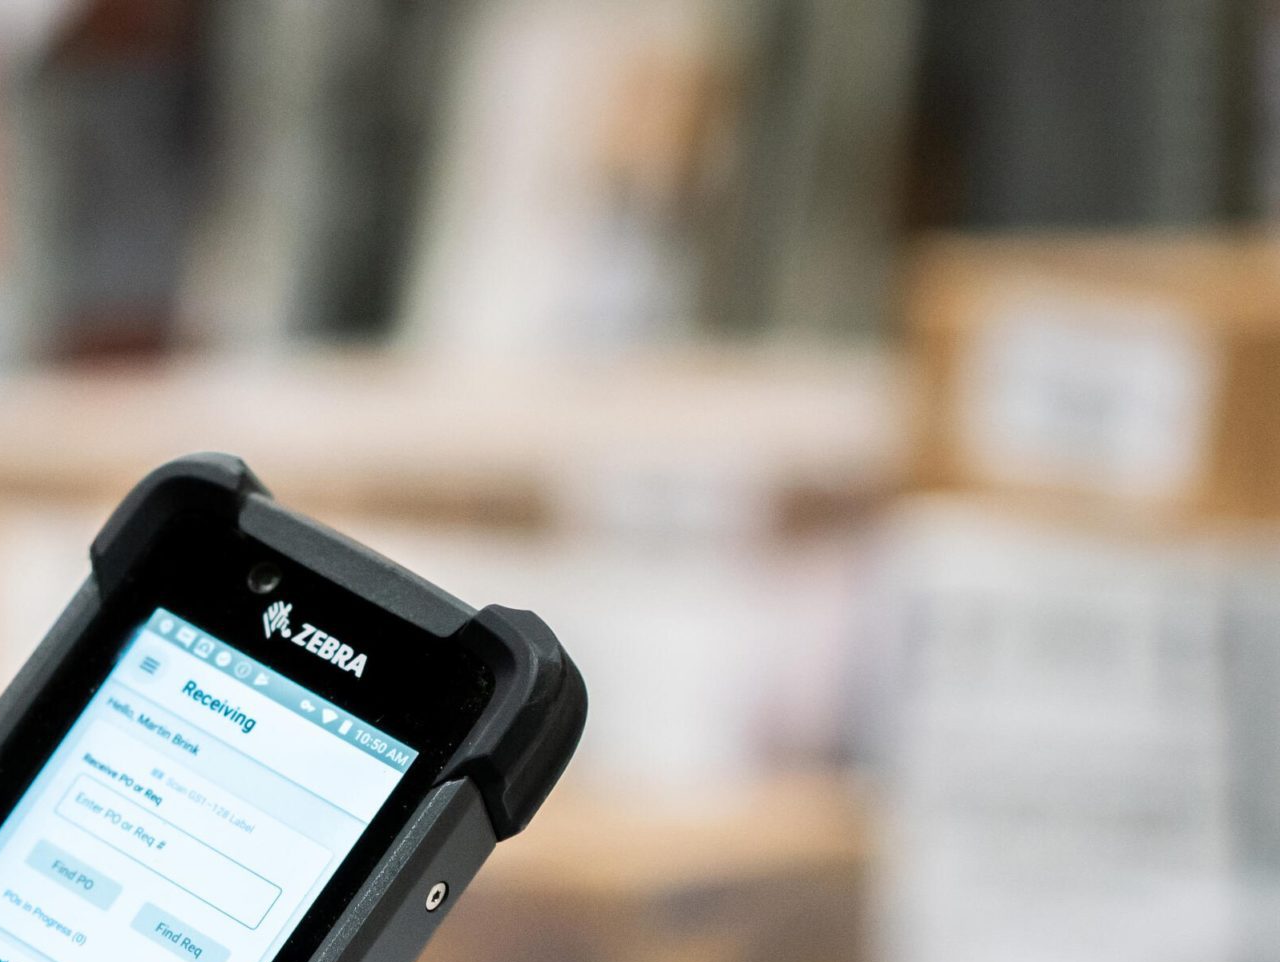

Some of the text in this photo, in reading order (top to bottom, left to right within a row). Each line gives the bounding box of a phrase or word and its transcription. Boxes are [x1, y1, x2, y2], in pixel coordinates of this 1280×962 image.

[290, 622, 368, 678] ZEBRA
[107, 697, 199, 756] Hello, Martin Brink
[182, 680, 257, 734] Receiving
[354, 729, 410, 767] 10:50 AM
[83, 752, 163, 807] Receive PO or Req
[74, 791, 166, 850] Enter PO or Req #
[228, 814, 256, 834] Label
[51, 859, 95, 891] Find PO
[3, 889, 87, 947] POs in Progress (0)
[154, 921, 203, 960] Find Req
